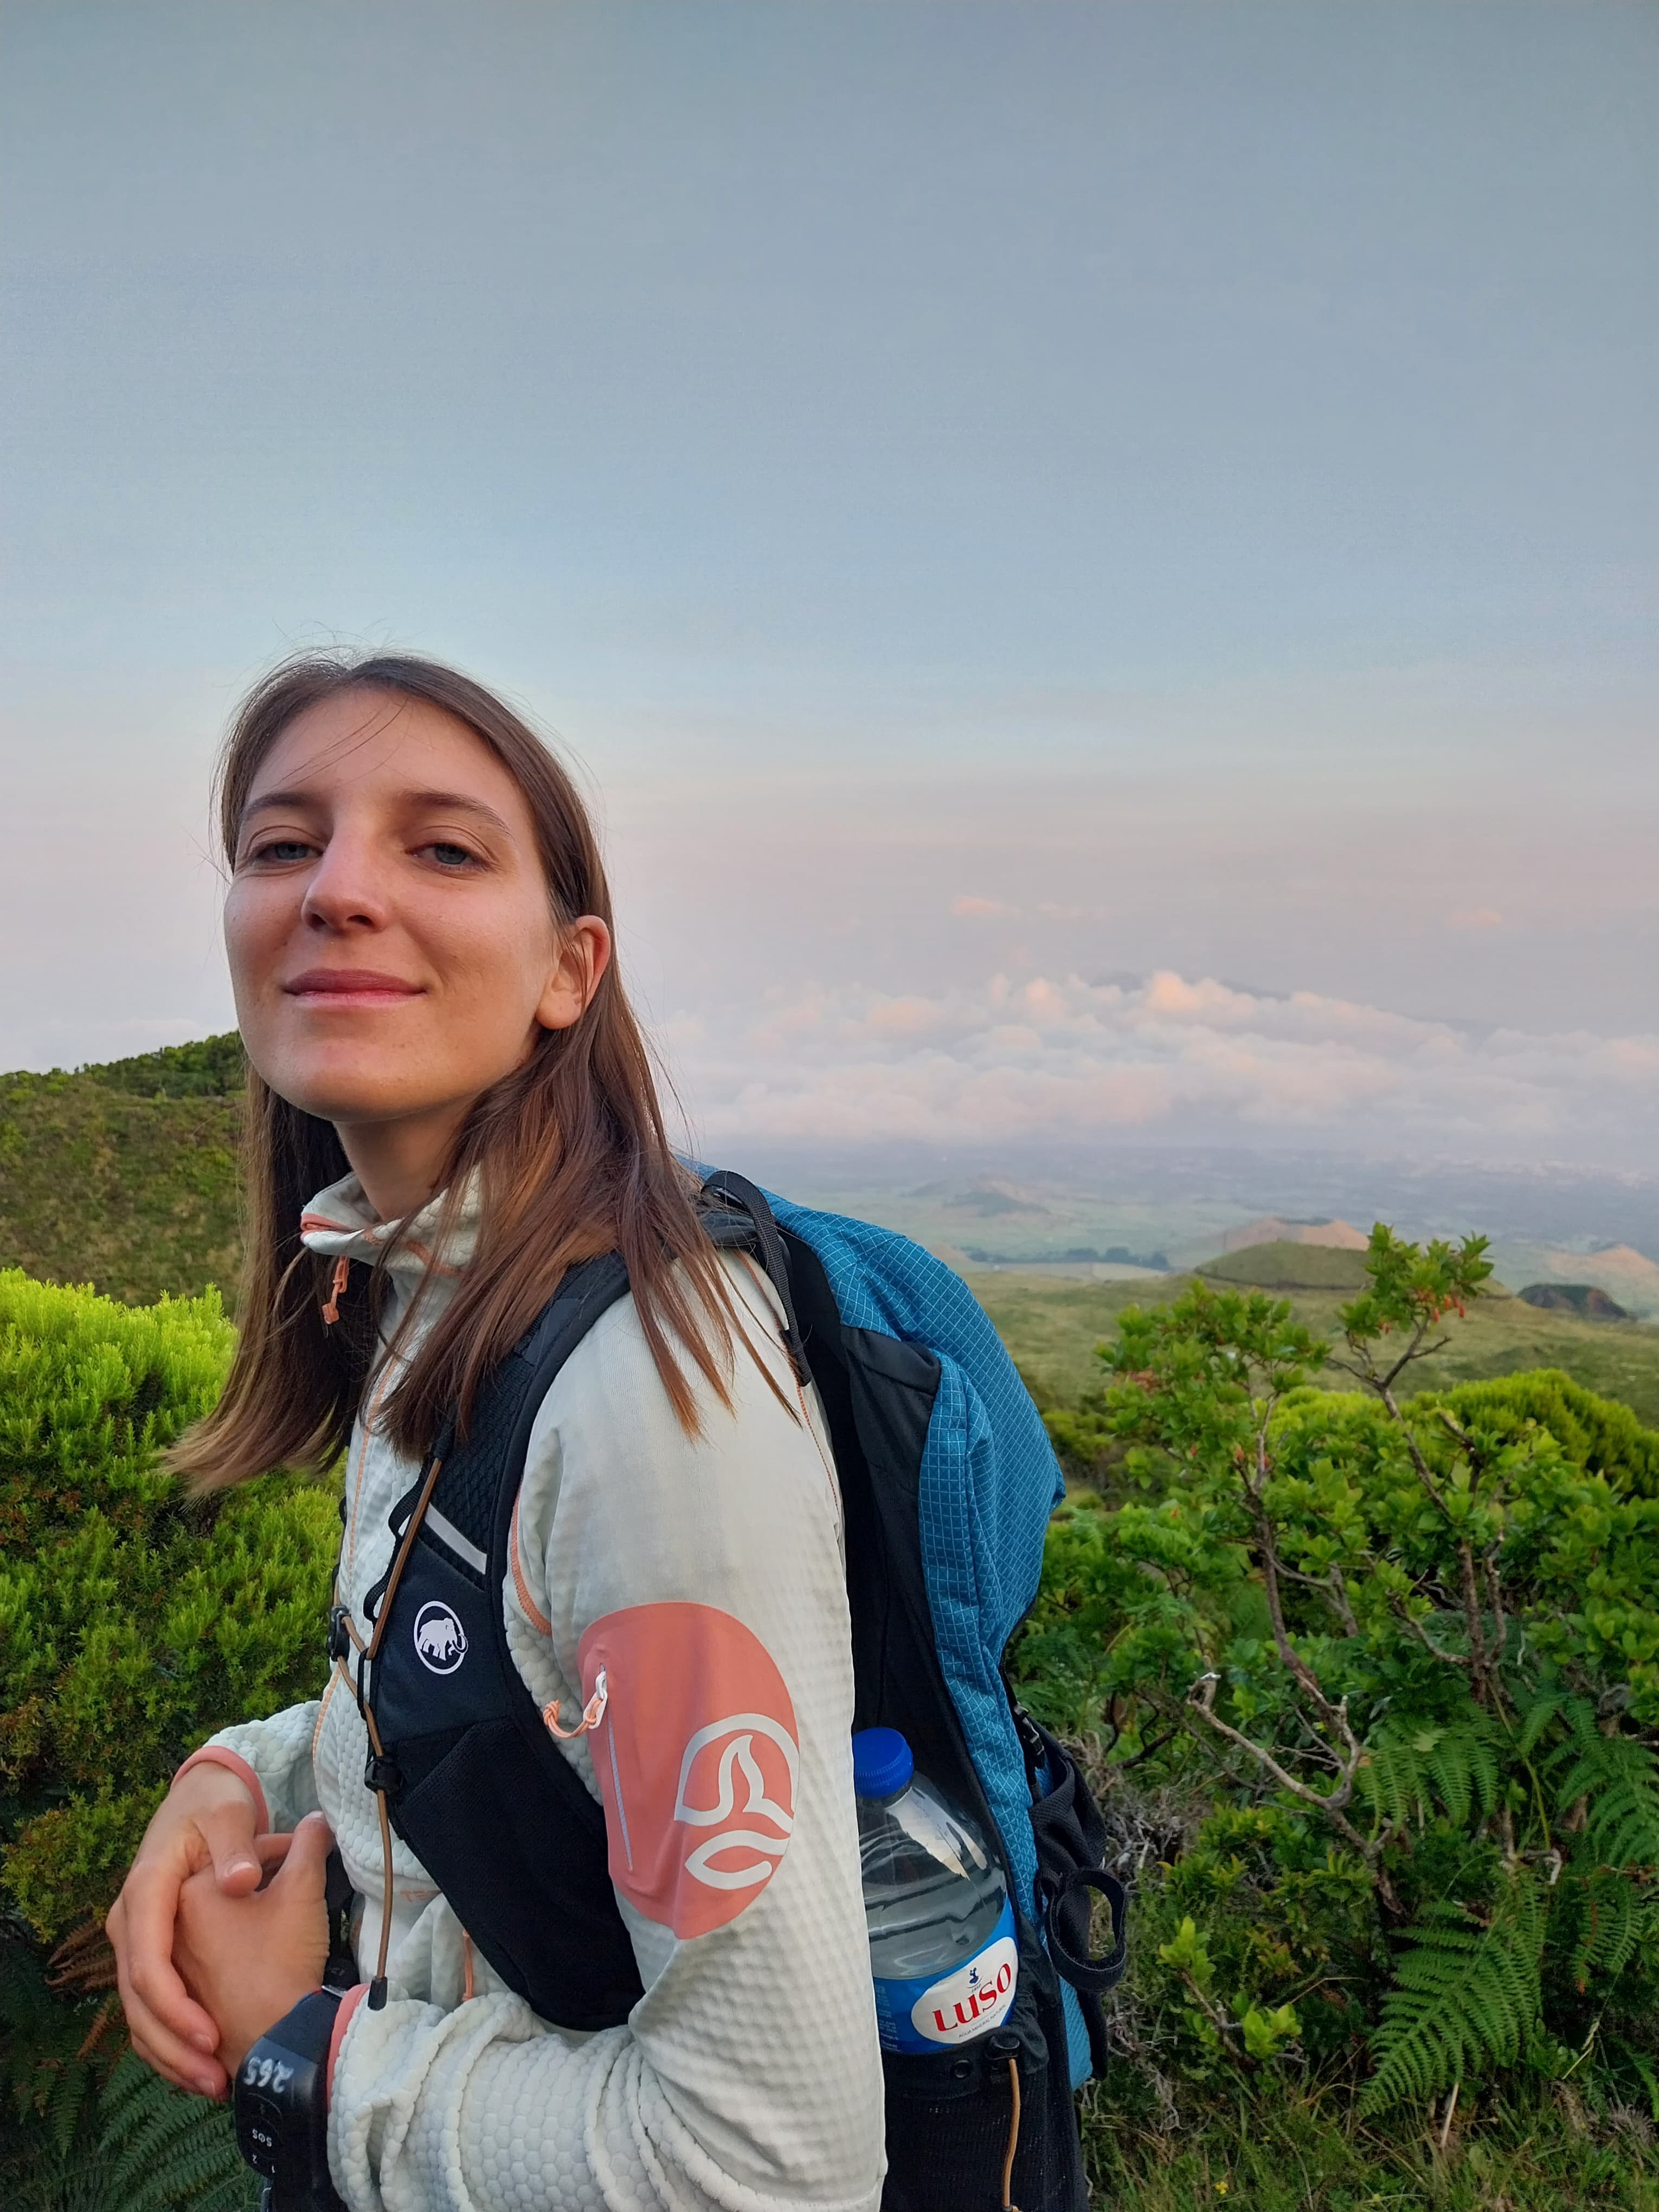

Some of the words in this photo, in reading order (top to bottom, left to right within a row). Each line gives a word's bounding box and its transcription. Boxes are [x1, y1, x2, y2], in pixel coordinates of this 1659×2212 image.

[932, 1963, 1011, 2031] LUSO
[243, 2056, 294, 2094] 265
[252, 2129, 272, 2147] SOS
